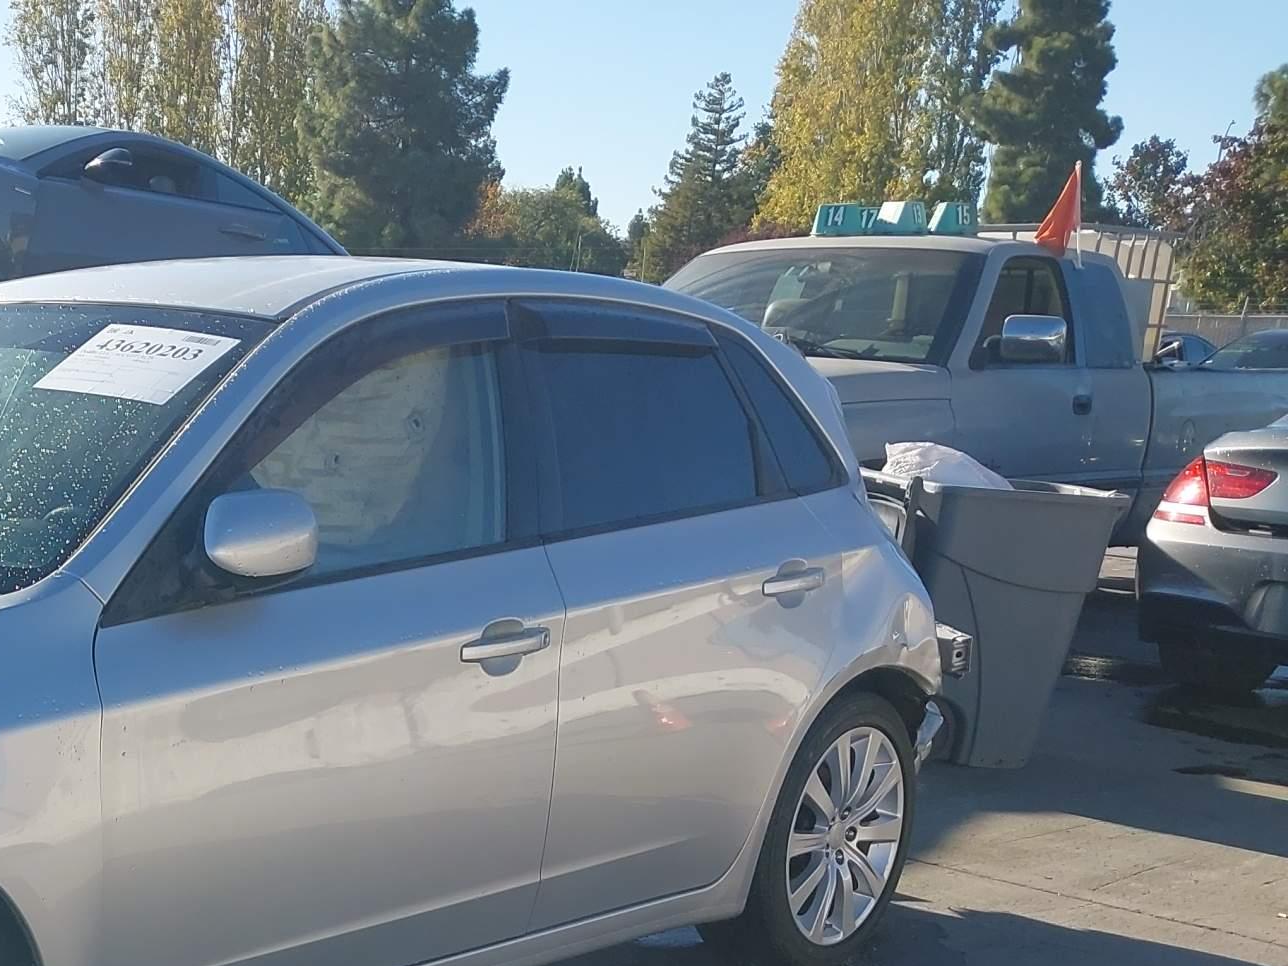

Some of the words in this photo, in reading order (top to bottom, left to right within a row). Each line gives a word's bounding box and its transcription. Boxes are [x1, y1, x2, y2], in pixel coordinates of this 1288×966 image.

[827, 206, 845, 227] 14
[861, 208, 879, 229] 17
[956, 205, 971, 225] 15
[96, 338, 203, 361] 43620203
